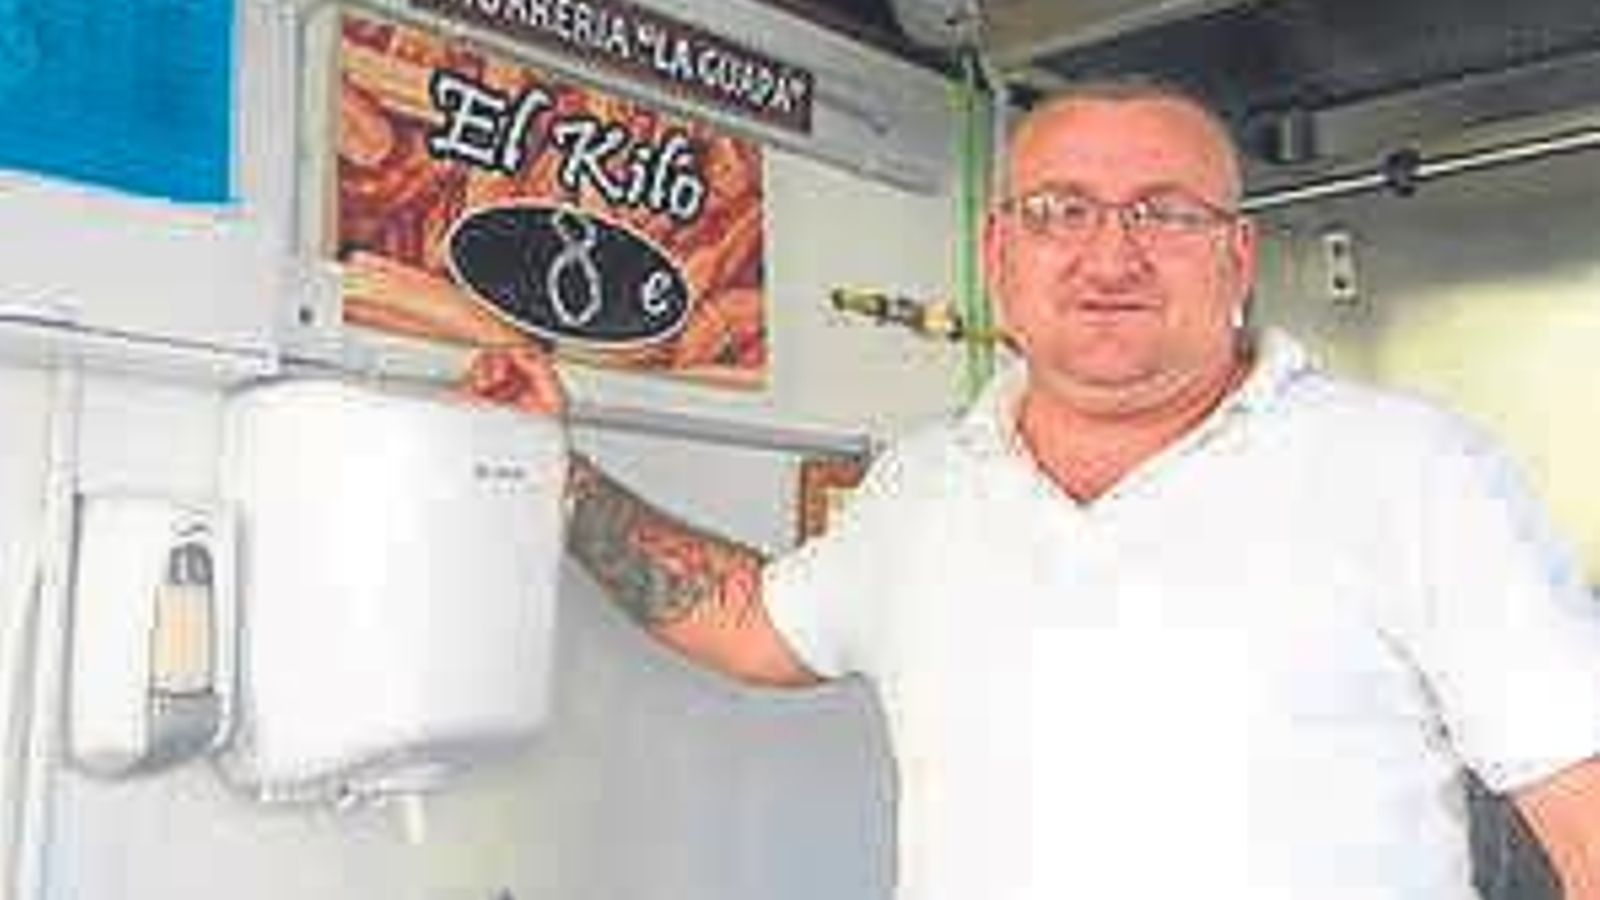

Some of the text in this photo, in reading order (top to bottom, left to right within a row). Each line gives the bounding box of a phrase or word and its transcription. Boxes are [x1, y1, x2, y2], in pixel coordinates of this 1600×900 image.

[431, 76, 703, 220] El Kilo
[547, 203, 601, 327] 8
